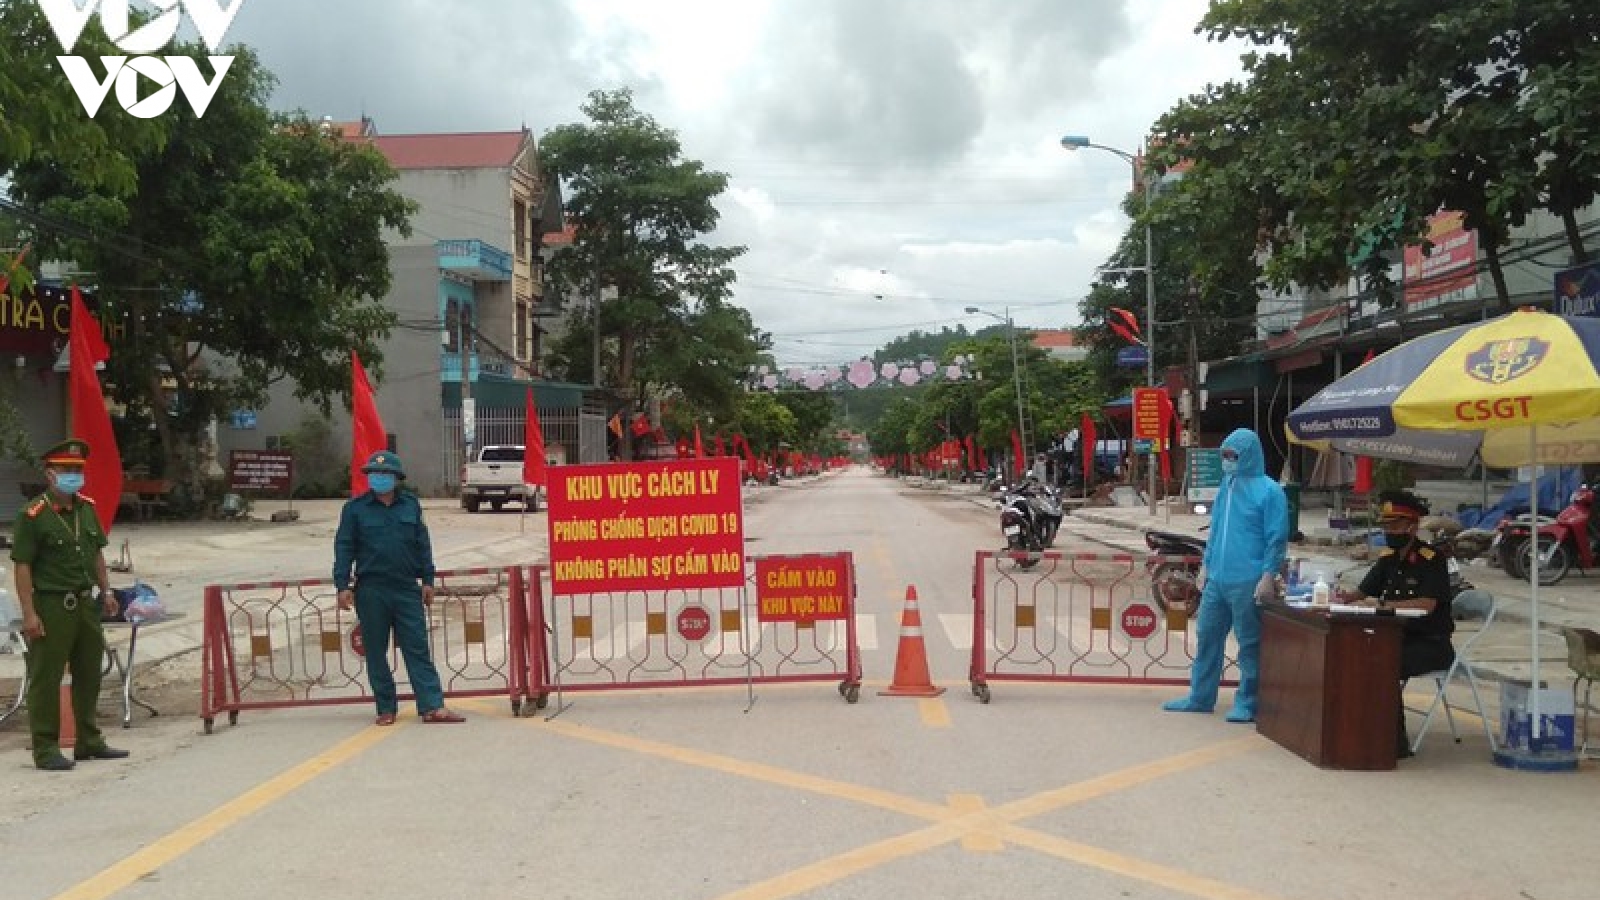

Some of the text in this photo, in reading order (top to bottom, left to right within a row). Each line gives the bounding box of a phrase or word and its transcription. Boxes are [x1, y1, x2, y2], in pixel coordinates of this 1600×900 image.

[1455, 396, 1533, 422] CSGT
[566, 467, 719, 504] KHU VỰC CÁCH LY
[553, 510, 737, 542] PHÒNG CHỐNG DỊCH COVID 19
[555, 548, 741, 581] KHÔNG PHÂN SỰ CẤM VÀO
[767, 566, 837, 589] CẤM VÀO
[762, 593, 843, 617] KHU VỰC NÀY
[1126, 615, 1152, 626] STOP
